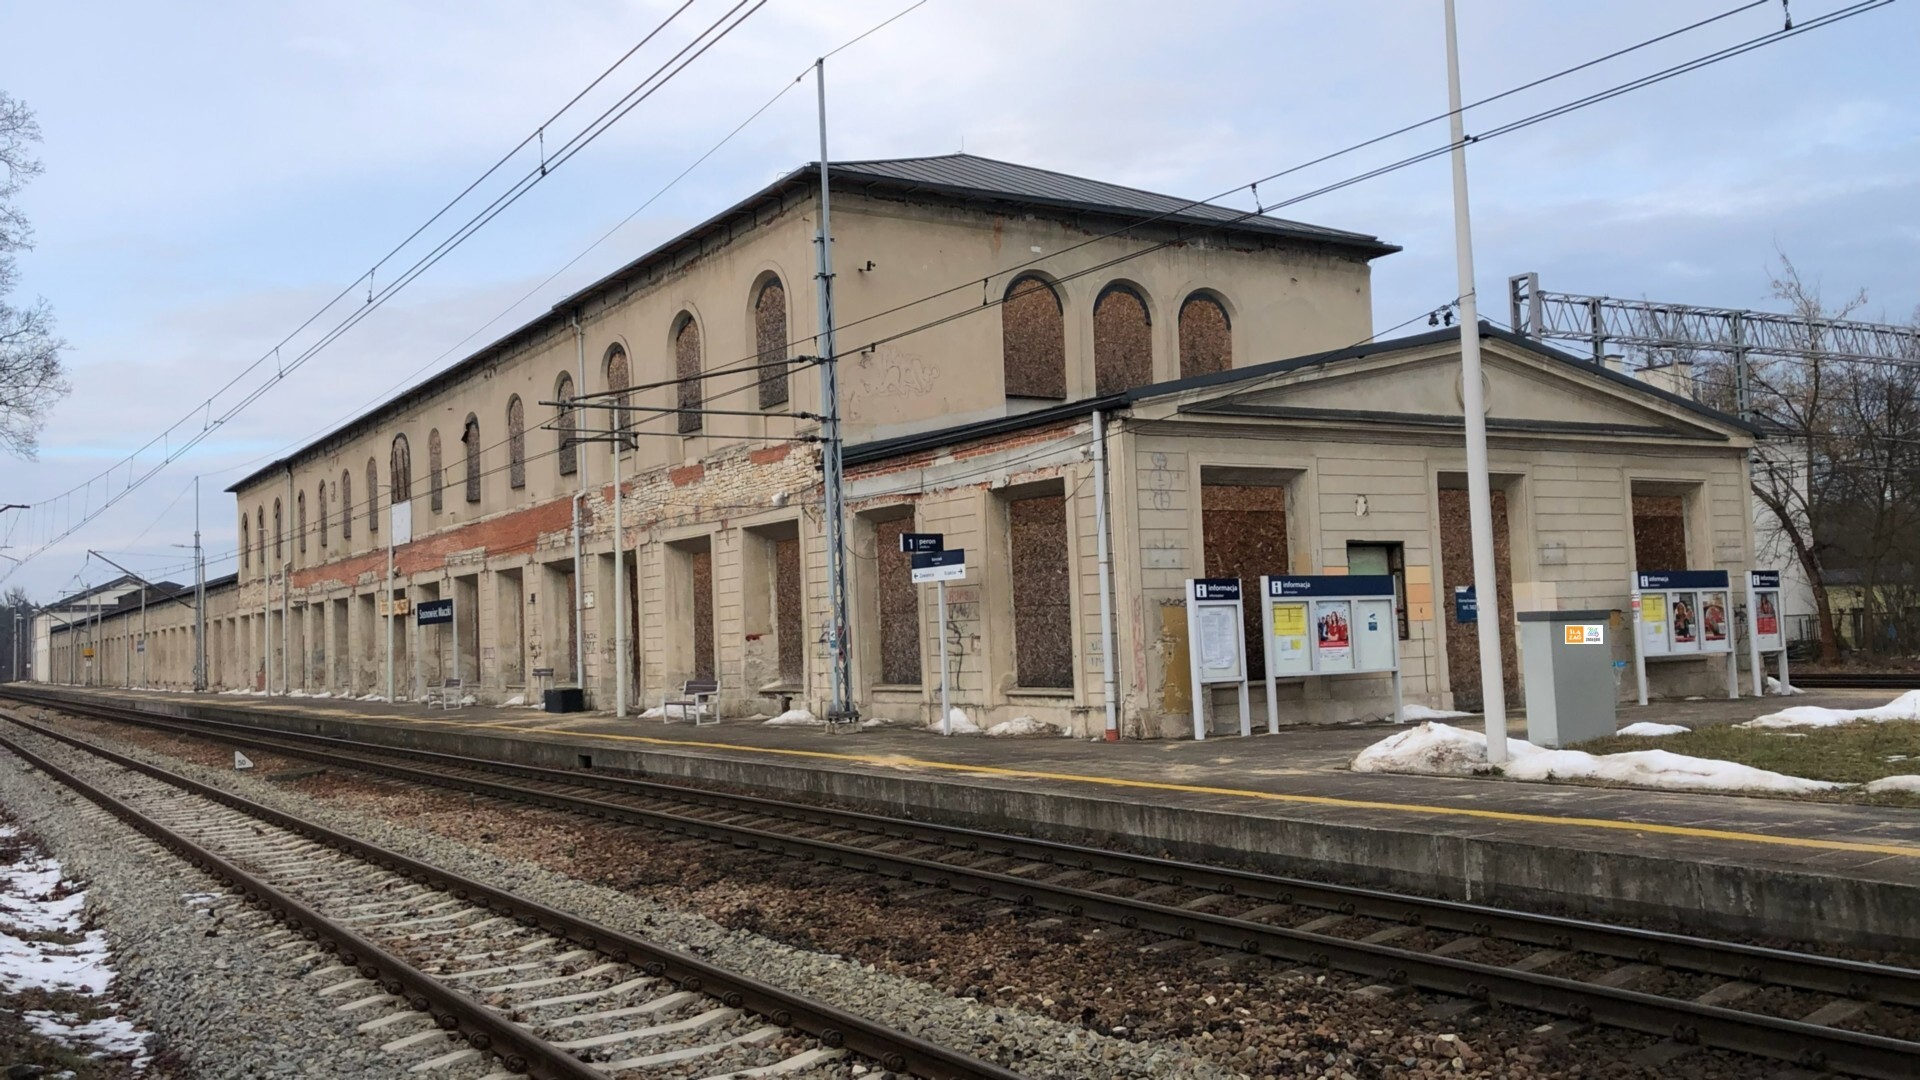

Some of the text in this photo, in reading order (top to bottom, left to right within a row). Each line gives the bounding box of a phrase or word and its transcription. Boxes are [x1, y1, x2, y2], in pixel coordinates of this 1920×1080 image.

[908, 538, 913, 549] 1
[1208, 584, 1238, 592] informacja
[1283, 581, 1311, 589] informacja
